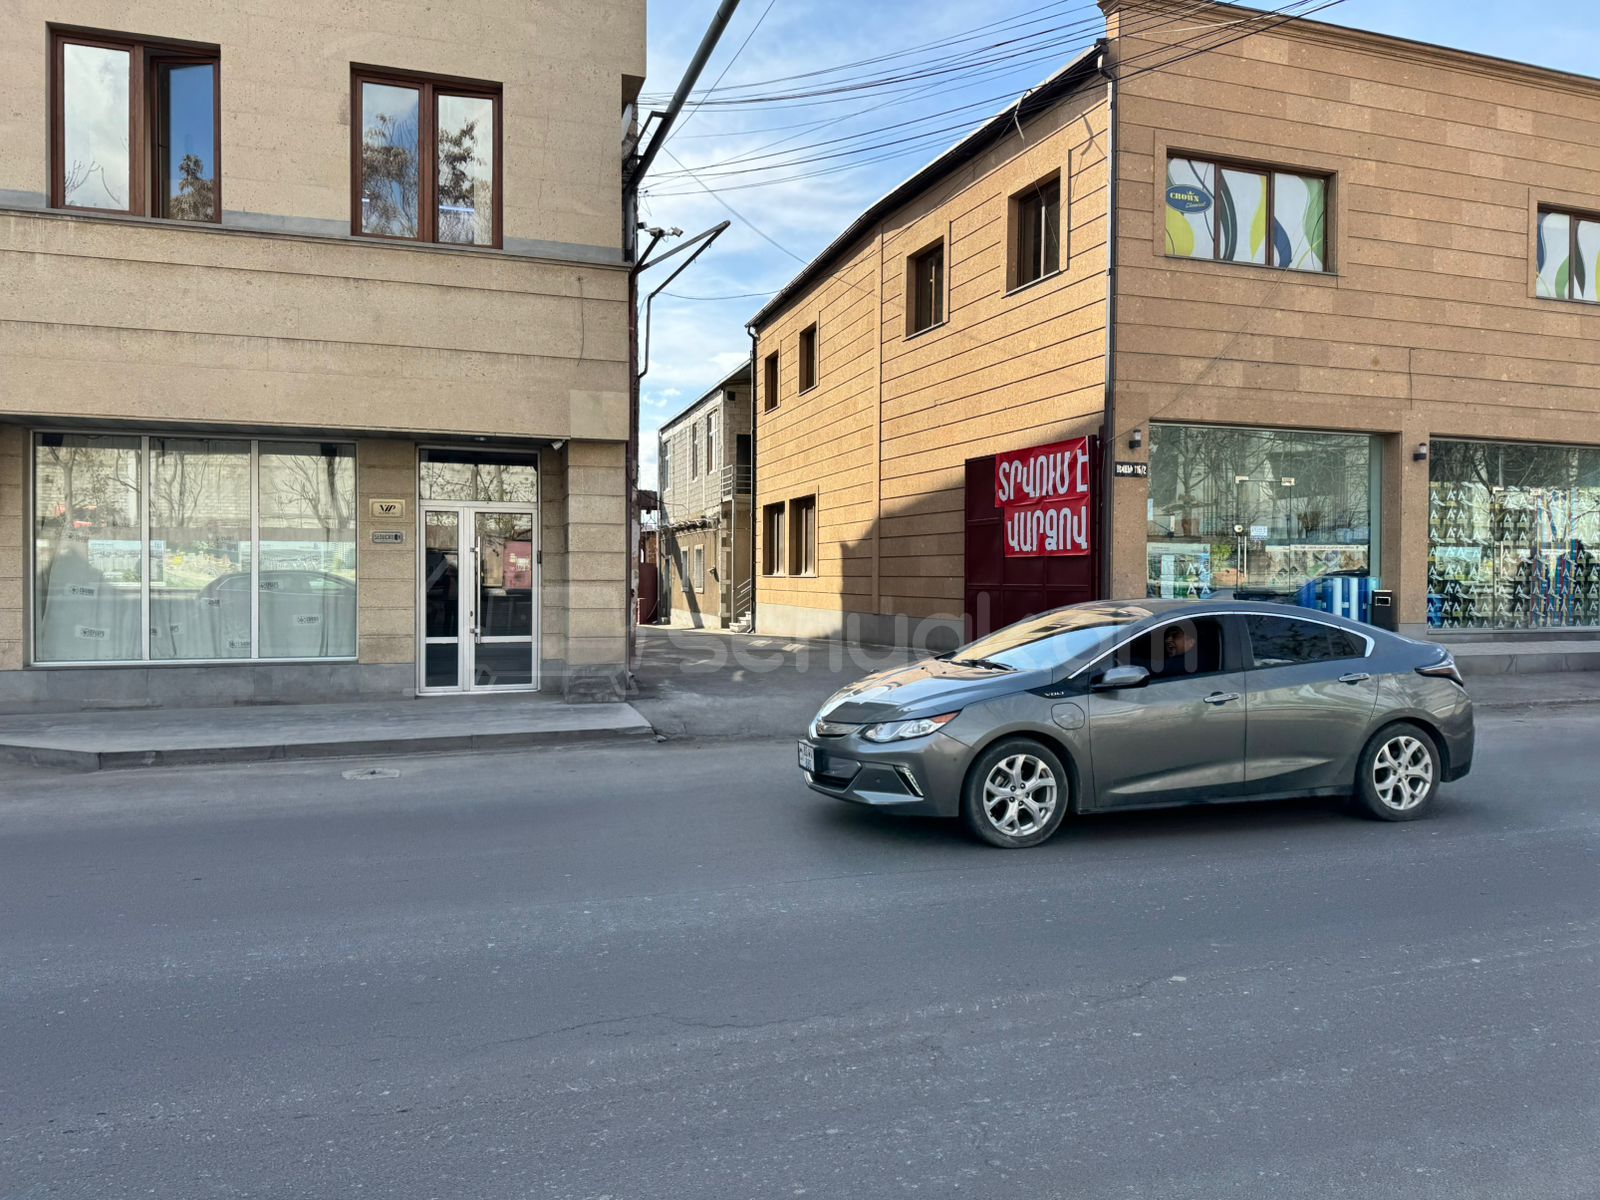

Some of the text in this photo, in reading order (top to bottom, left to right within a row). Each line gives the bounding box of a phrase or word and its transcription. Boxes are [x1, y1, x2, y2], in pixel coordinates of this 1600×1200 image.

[1170, 192, 1200, 202] CROWN
[998, 449, 1089, 502] ՏՐՎՈՒՄ Է
[1007, 506, 1088, 552] ՎԱՐՁՈՎ
